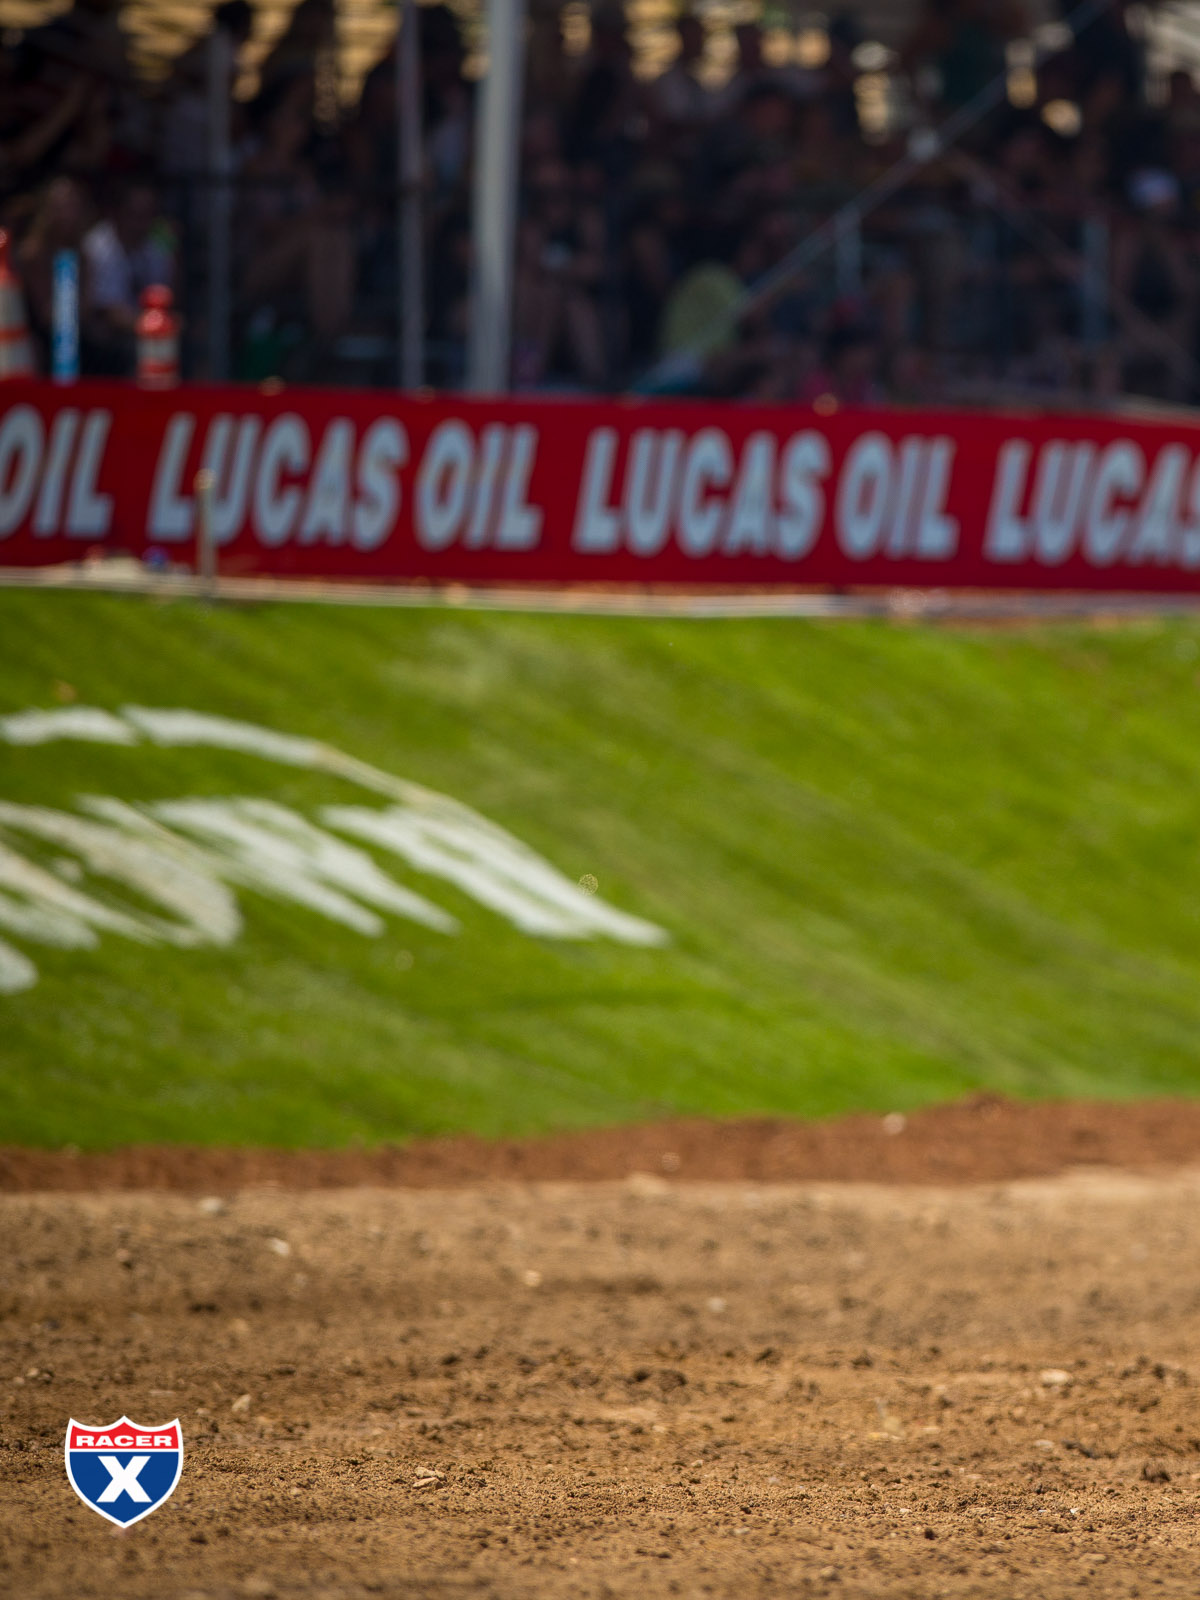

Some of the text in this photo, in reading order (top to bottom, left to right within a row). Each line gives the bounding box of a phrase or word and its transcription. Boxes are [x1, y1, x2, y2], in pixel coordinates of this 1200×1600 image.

[146, 411, 409, 551] LUCAS
[414, 418, 543, 551] OIL
[571, 425, 831, 562] LUCAS
[834, 430, 960, 562] OIL
